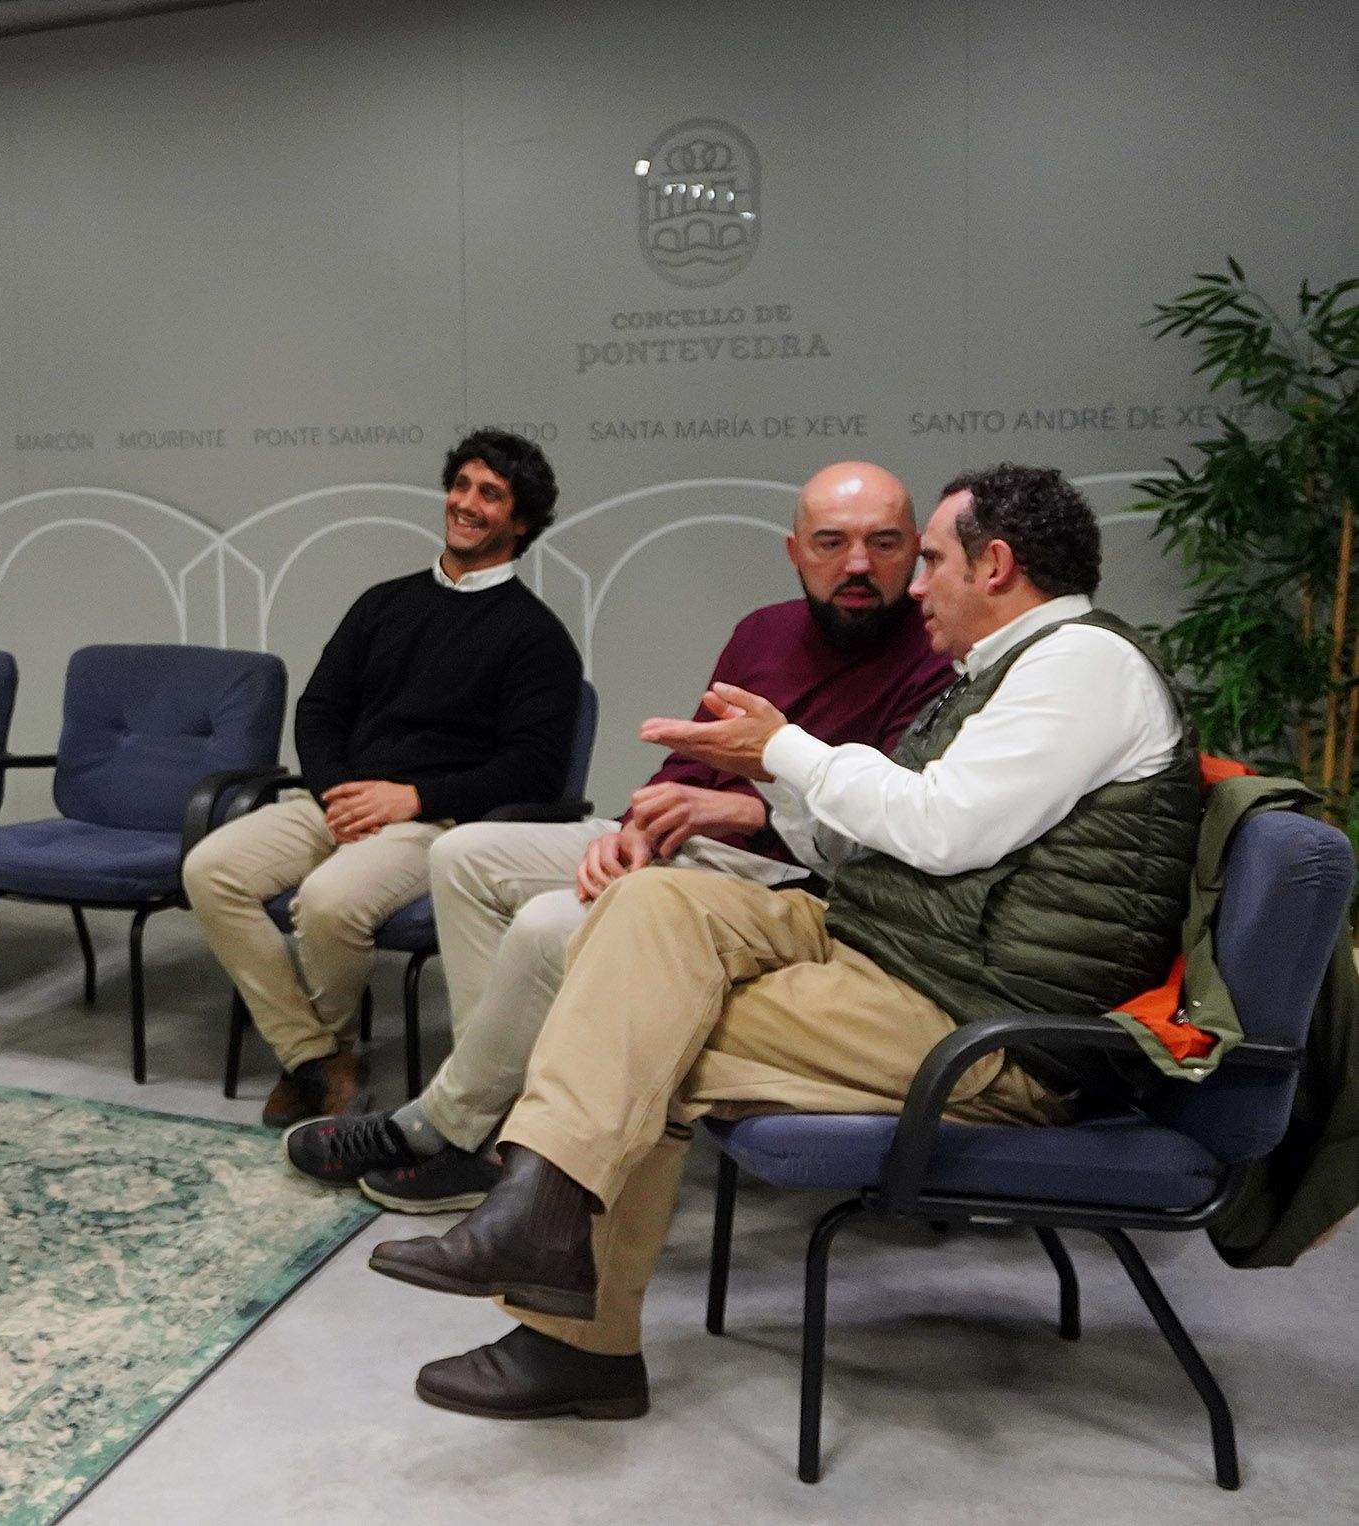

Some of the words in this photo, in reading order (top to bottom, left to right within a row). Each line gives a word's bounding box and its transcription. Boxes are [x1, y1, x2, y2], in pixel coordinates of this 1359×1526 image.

[611, 307, 746, 330] CONCELLO
[754, 304, 792, 324] DE
[591, 419, 667, 441] SANTA
[675, 414, 755, 439] MARÍA
[764, 416, 796, 438] DE
[805, 414, 868, 437] XEVE
[910, 410, 1005, 435] SANTO
[1013, 402, 1116, 431] ANDRÉ
[1127, 405, 1166, 430] DE
[118, 429, 225, 450] MOURENTE
[253, 425, 320, 446] PONTE
[328, 424, 424, 445] SAMPAIO
